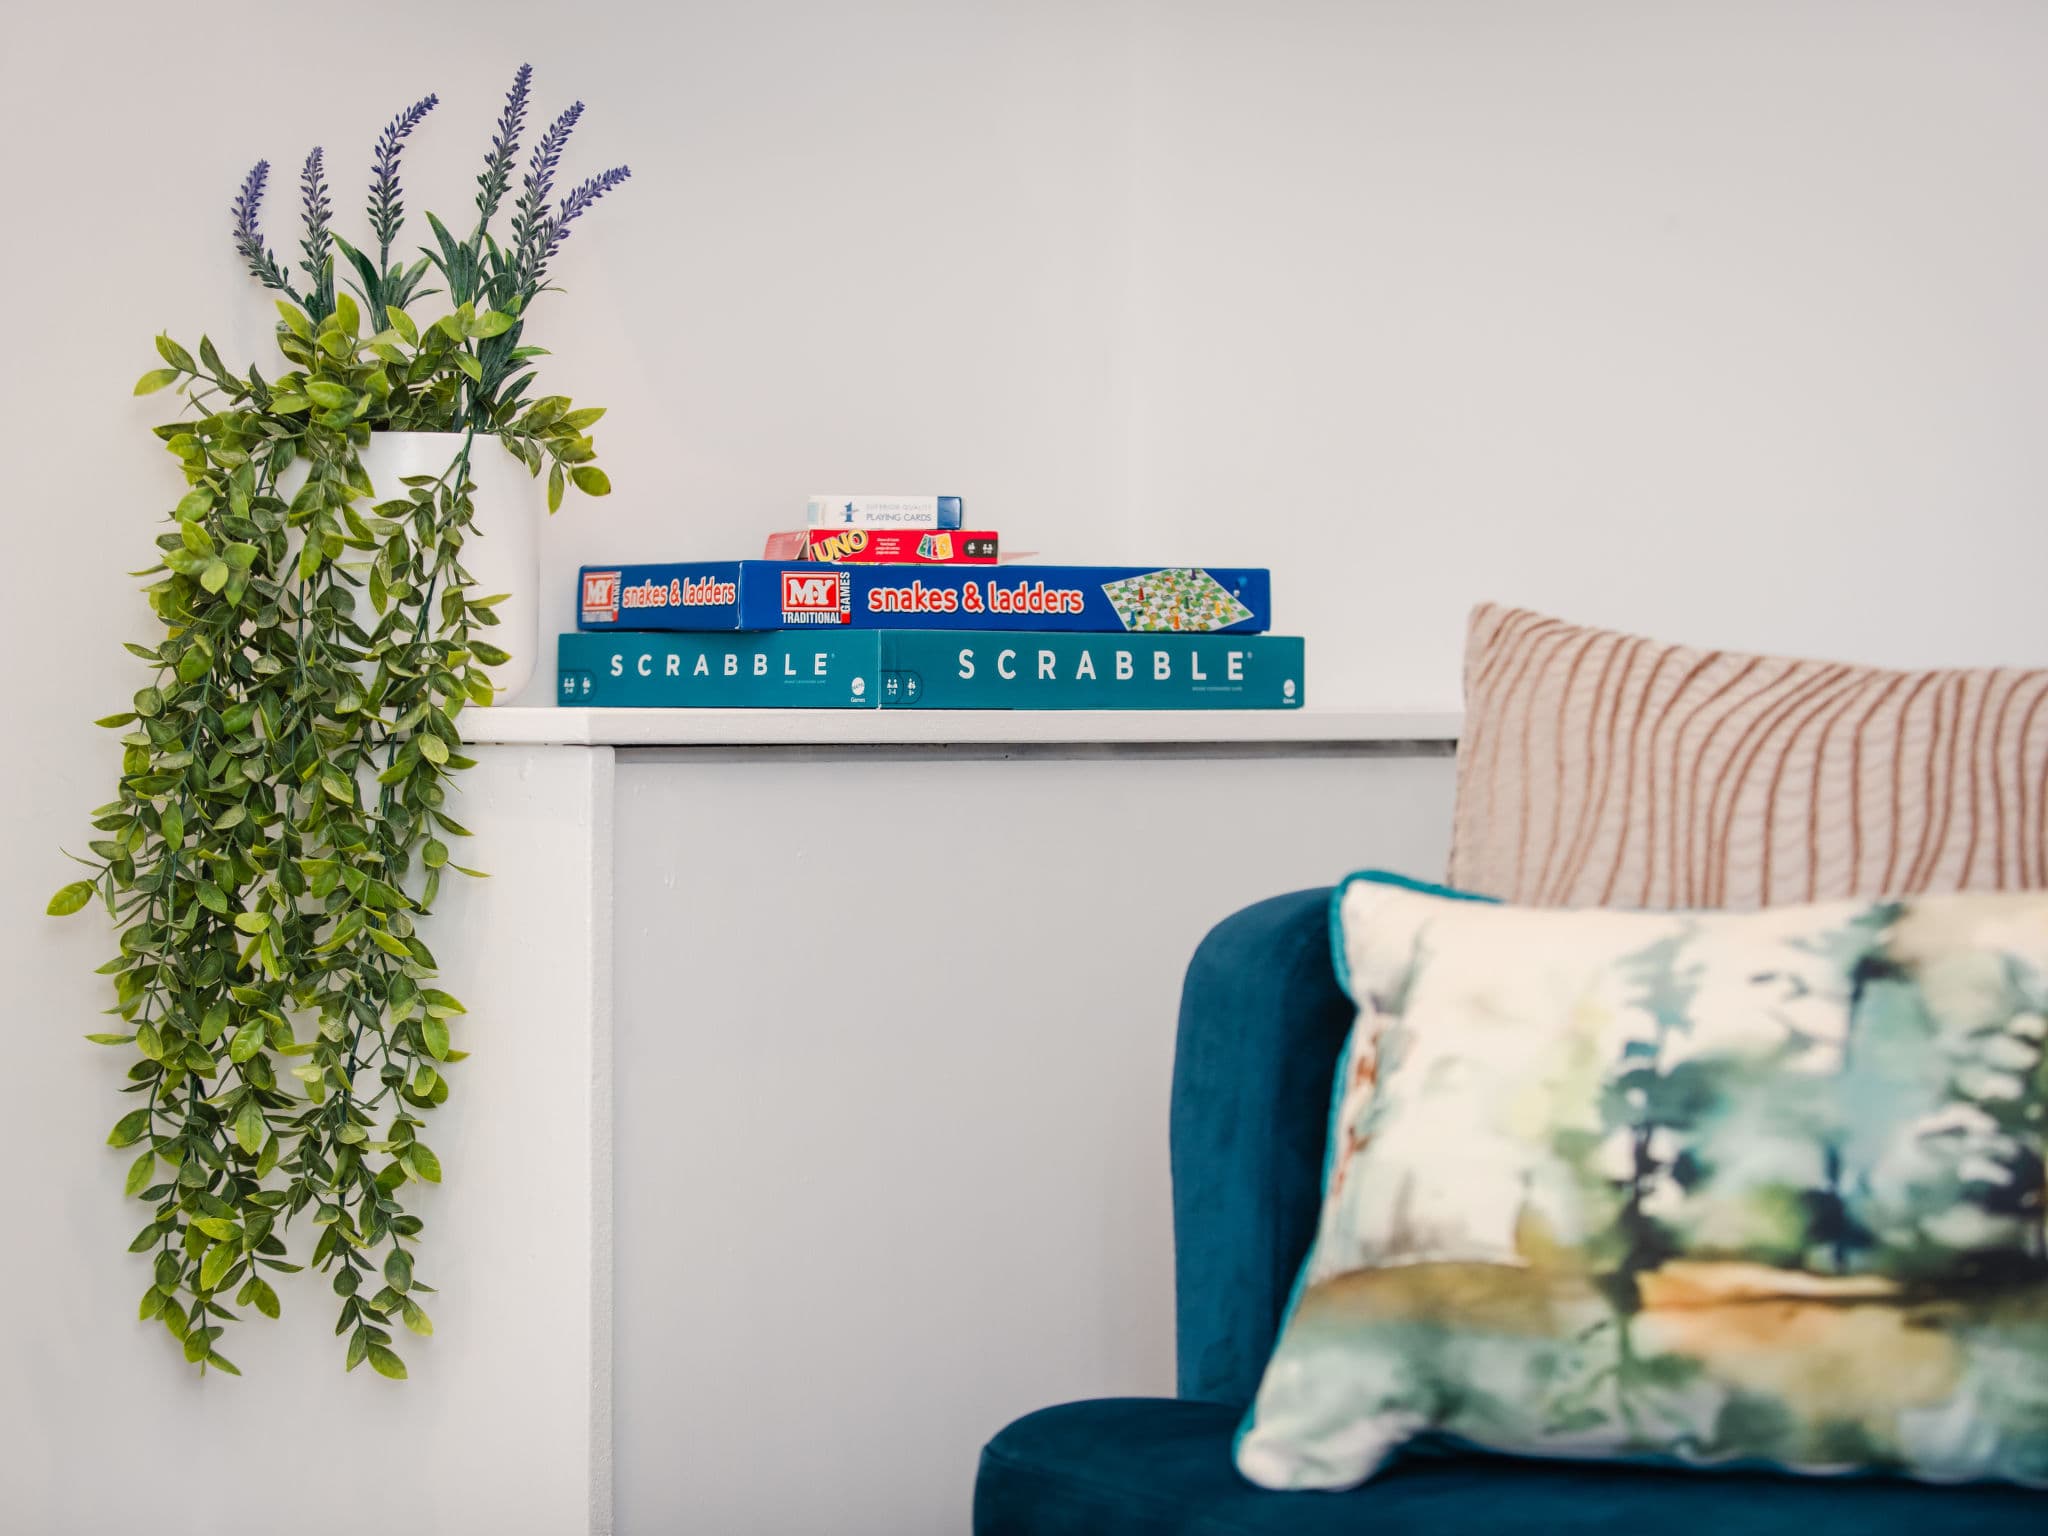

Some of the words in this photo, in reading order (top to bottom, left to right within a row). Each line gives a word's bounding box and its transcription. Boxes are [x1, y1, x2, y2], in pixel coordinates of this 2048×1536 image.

[866, 513, 901, 522] PLAYING
[903, 513, 932, 522] CARDS
[810, 529, 869, 562] UNO
[622, 579, 667, 608] snakes
[669, 582, 681, 607] &
[682, 576, 736, 606] ladders
[840, 571, 851, 613] GAMES
[868, 580, 957, 613] snakes
[963, 582, 983, 610] &
[988, 581, 1084, 614] ladders
[782, 612, 841, 624] TRADITIONAL
[610, 653, 828, 677] SCRABBLE
[958, 649, 1244, 681] SCRABBLE
